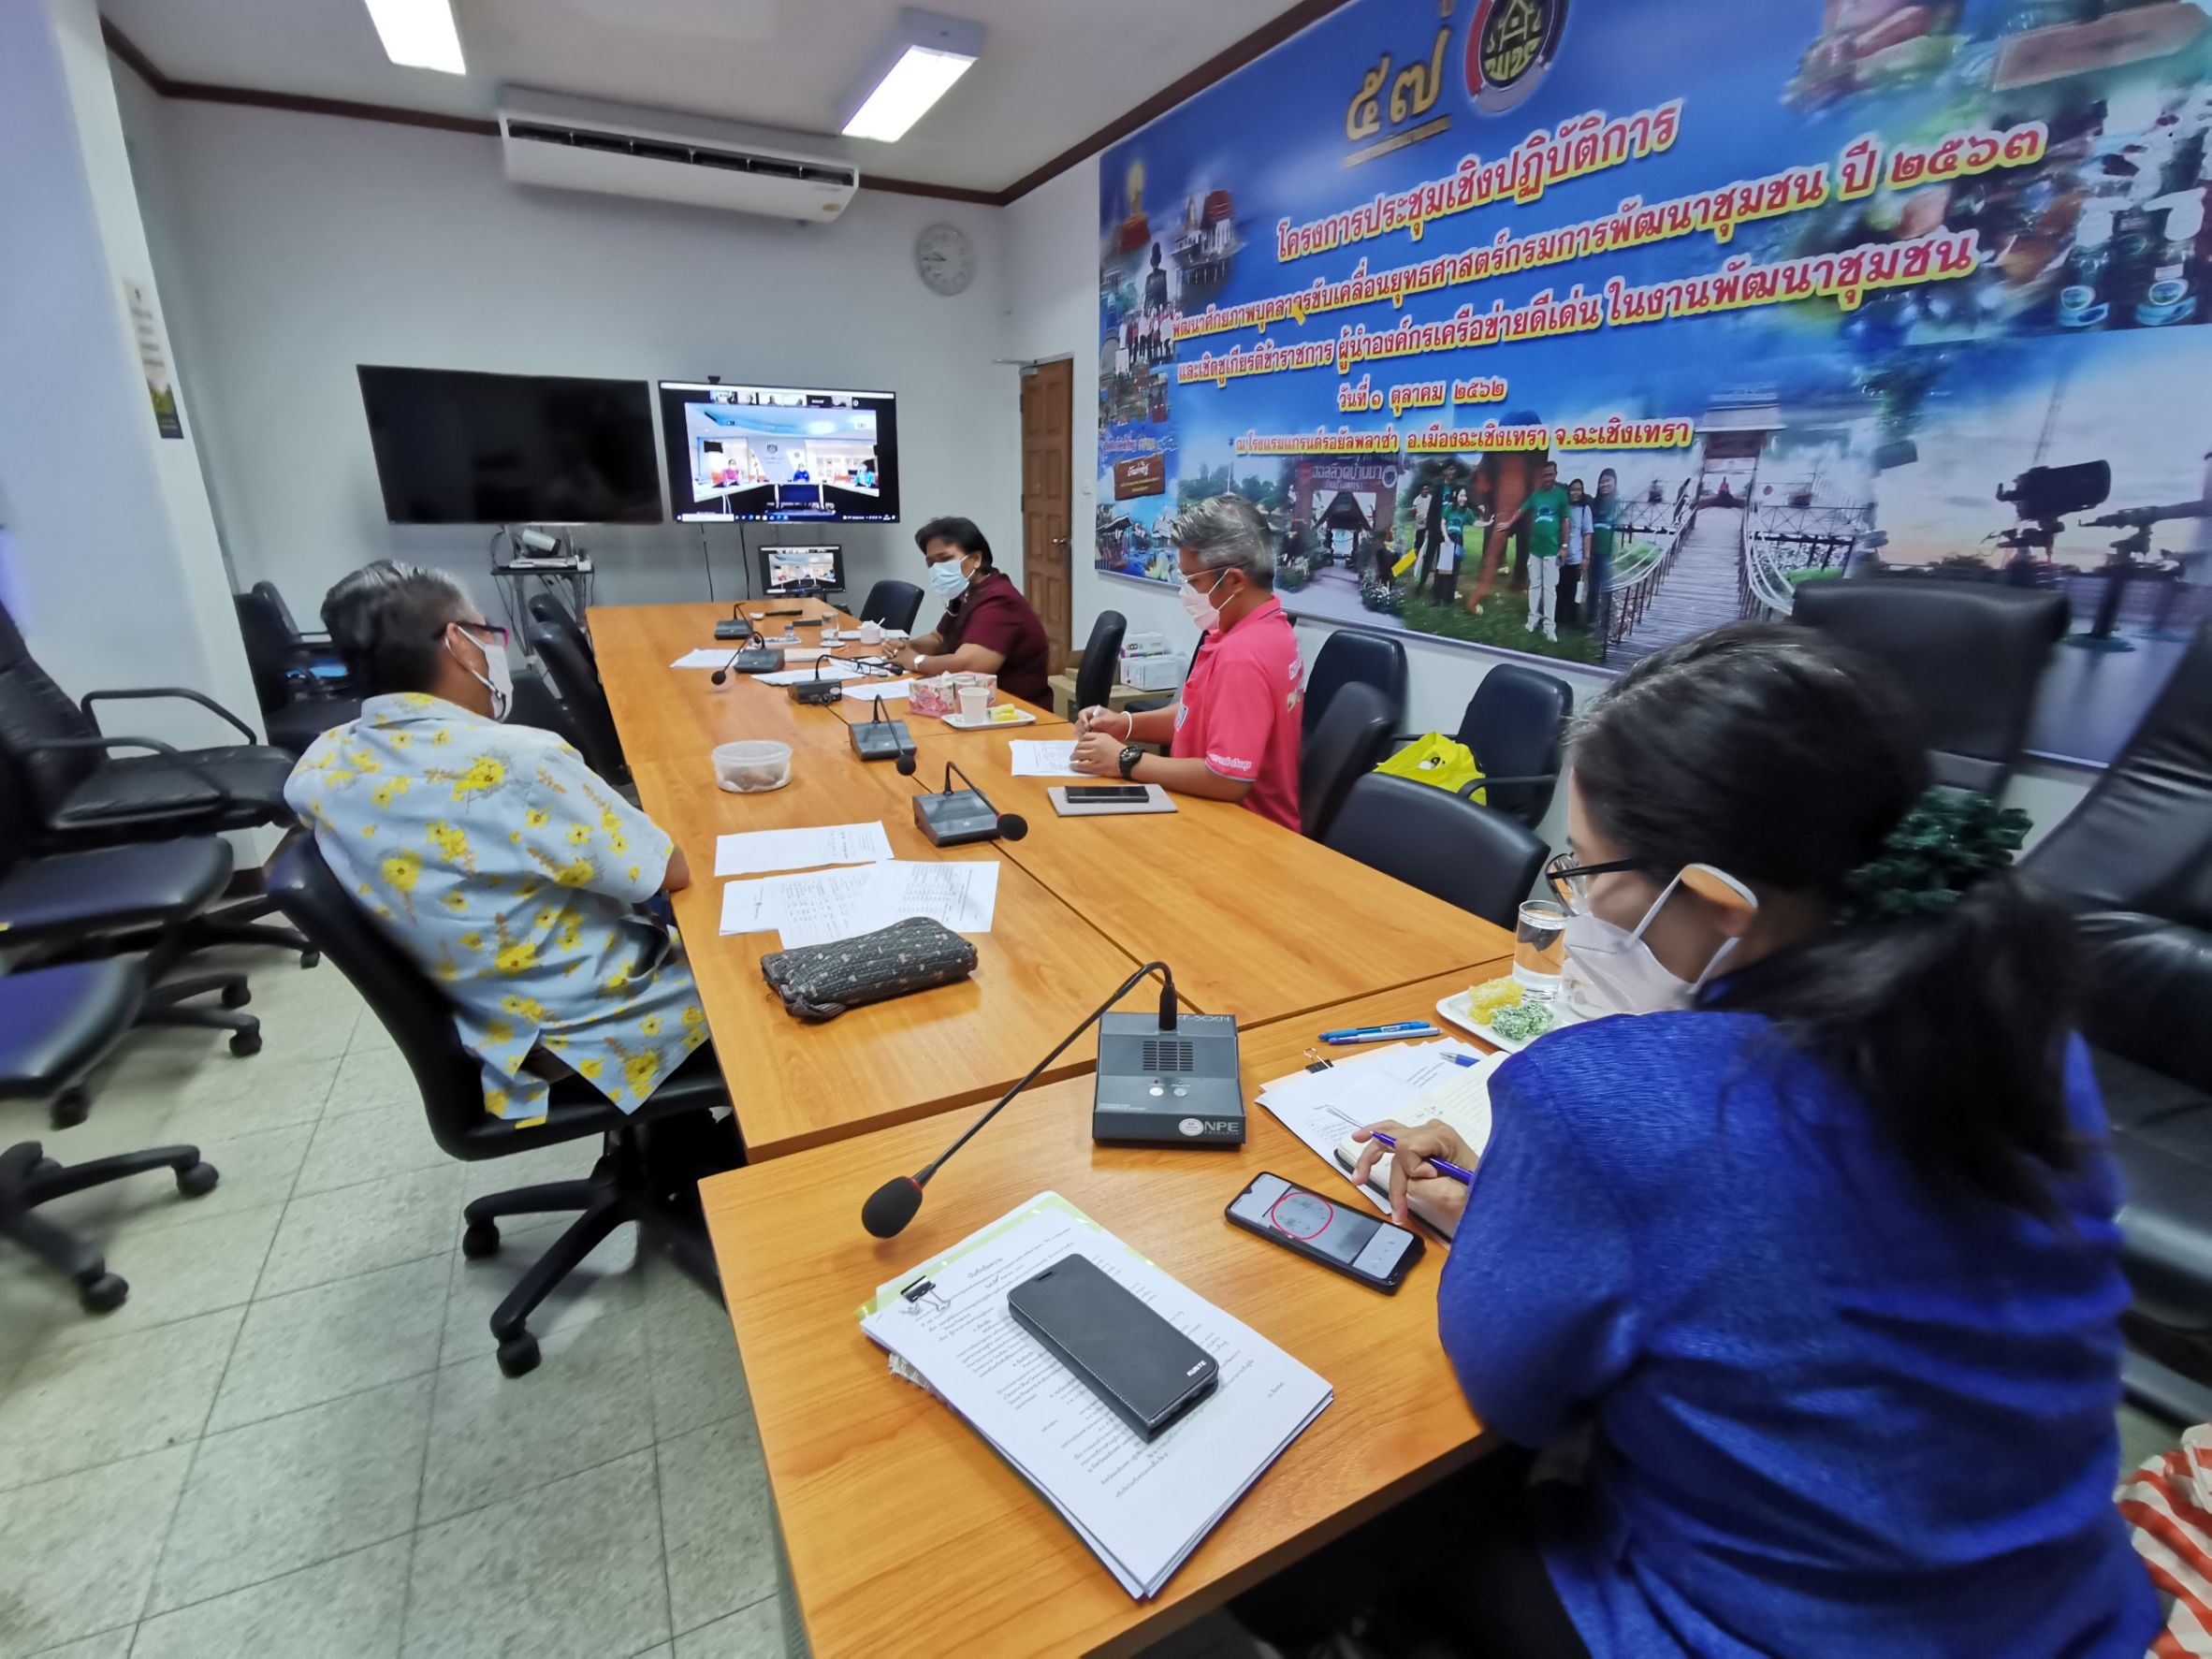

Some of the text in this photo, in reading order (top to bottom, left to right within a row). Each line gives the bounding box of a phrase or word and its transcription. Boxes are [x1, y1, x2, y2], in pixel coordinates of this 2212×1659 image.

[1278, 105, 1678, 260] โครงการประชุมเชิงปฏิบัติการ
[1841, 143, 1876, 195] ปี
[1891, 128, 2040, 182] ๒๕๖๓
[1338, 289, 1598, 371] ผู้นำองค์กรเครือข่ายดีเด่น
[1608, 235, 1972, 320] ในงานพัฒนาชุมชน
[1390, 385, 1444, 413] ตุลาคม
[1454, 381, 1505, 400] ๒๕๖๒
[1204, 1121, 1240, 1131] NPE
